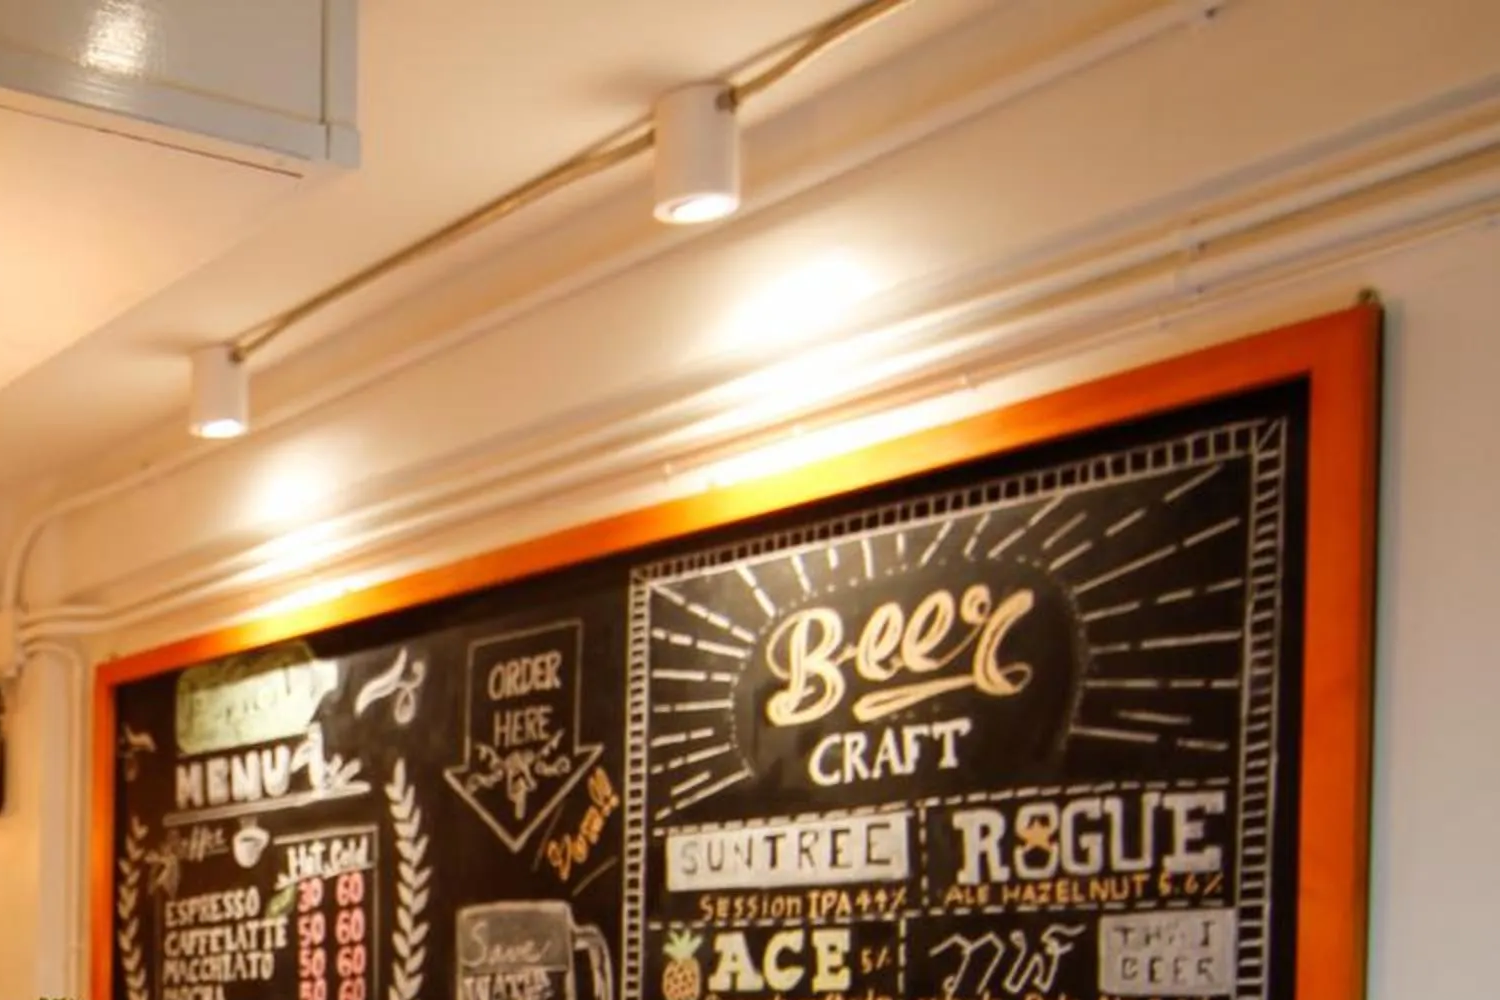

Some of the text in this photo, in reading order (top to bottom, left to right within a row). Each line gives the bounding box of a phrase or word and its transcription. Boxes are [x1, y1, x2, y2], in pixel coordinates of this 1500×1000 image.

[487, 650, 562, 700] ORDER
[766, 584, 1034, 726] Beer
[493, 705, 553, 748] HERE
[808, 717, 973, 786] CRAFT
[175, 744, 290, 810] MENU
[679, 821, 892, 876] SUNTREE
[952, 790, 1226, 886] ROGUE
[164, 885, 260, 928] ESPRESSO
[336, 871, 364, 907] 60
[699, 893, 801, 923] Session
[806, 888, 852, 920] IPA
[944, 884, 989, 904] ALE
[298, 911, 326, 948] 50
[335, 907, 365, 944] 60
[299, 947, 327, 979] 50
[336, 944, 366, 978] 60
[707, 927, 852, 993] ACE
[1120, 957, 1215, 984] BEER
